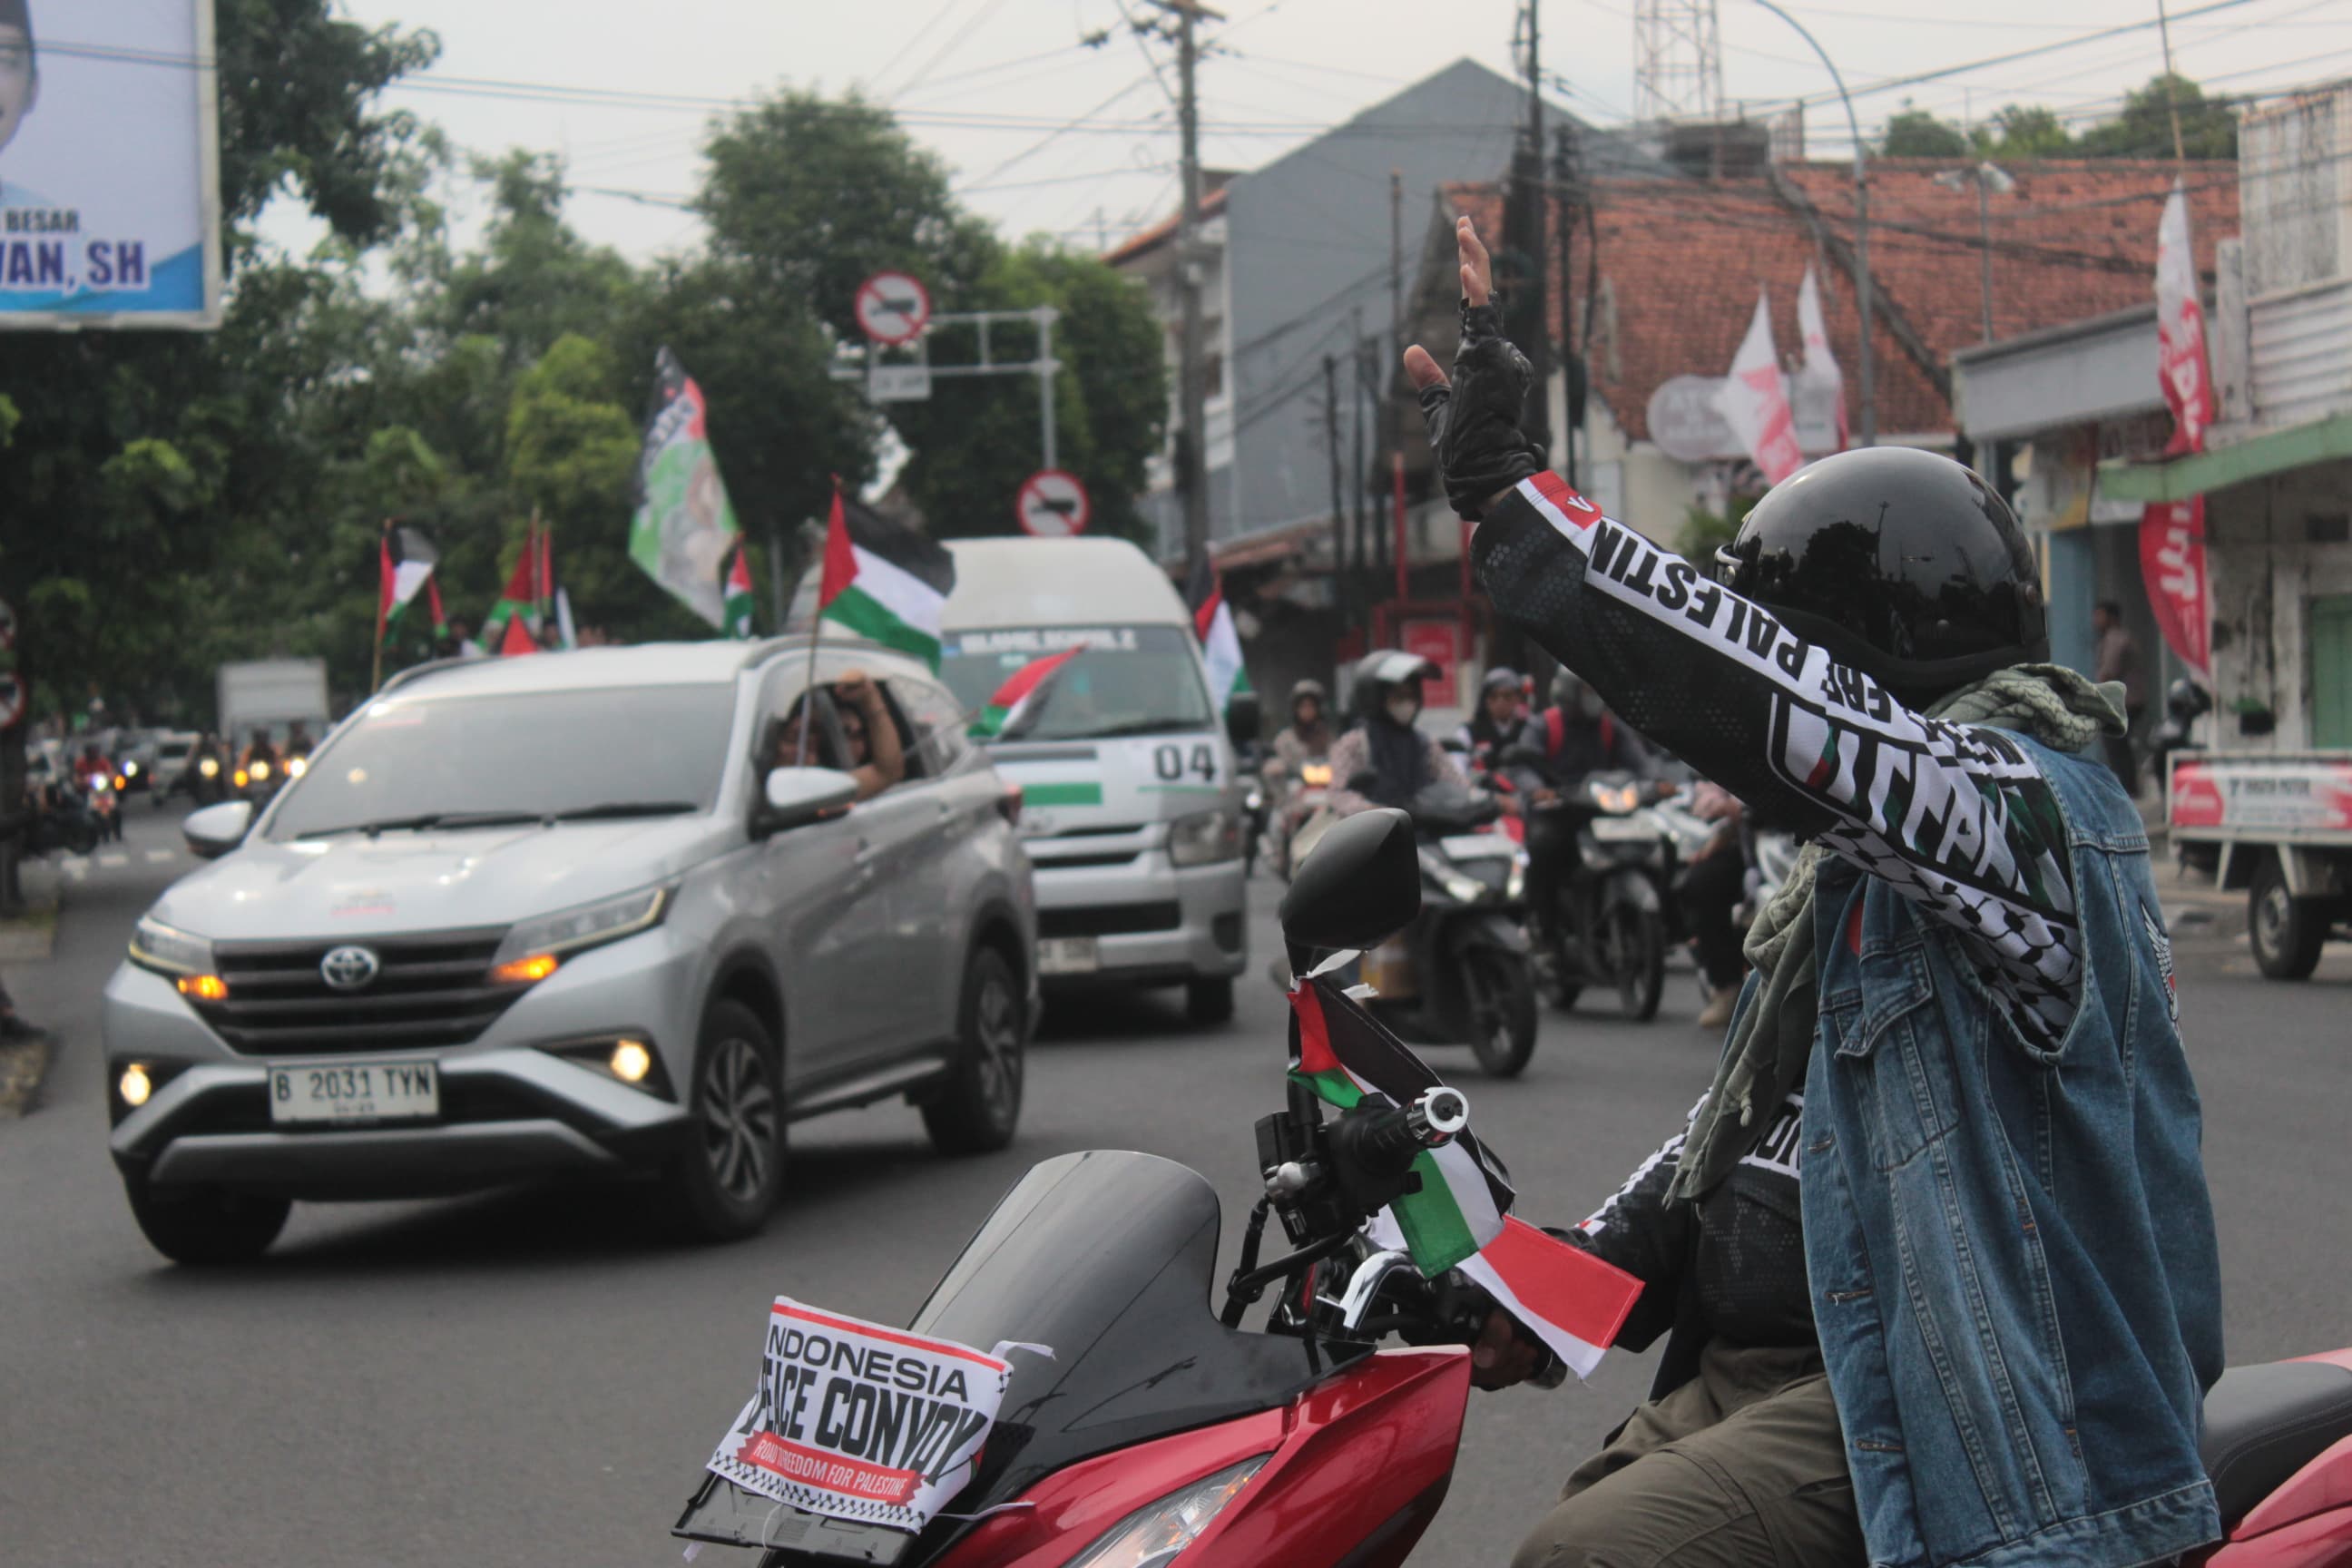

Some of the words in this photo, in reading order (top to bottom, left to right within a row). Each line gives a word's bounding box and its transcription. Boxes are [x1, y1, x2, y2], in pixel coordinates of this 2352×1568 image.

[6, 209, 80, 233] BESAR
[87, 239, 144, 286] SH
[1154, 744, 1217, 781] 04
[275, 1073, 291, 1102] B
[309, 1068, 372, 1100] 2031
[383, 1065, 431, 1096] TYN
[769, 1325, 968, 1403] NDONESIA
[815, 1376, 988, 1487] CONVOY
[754, 1440, 779, 1465] ROAD
[827, 1464, 854, 1487] FOR
[853, 1470, 908, 1496] PALESTINE
